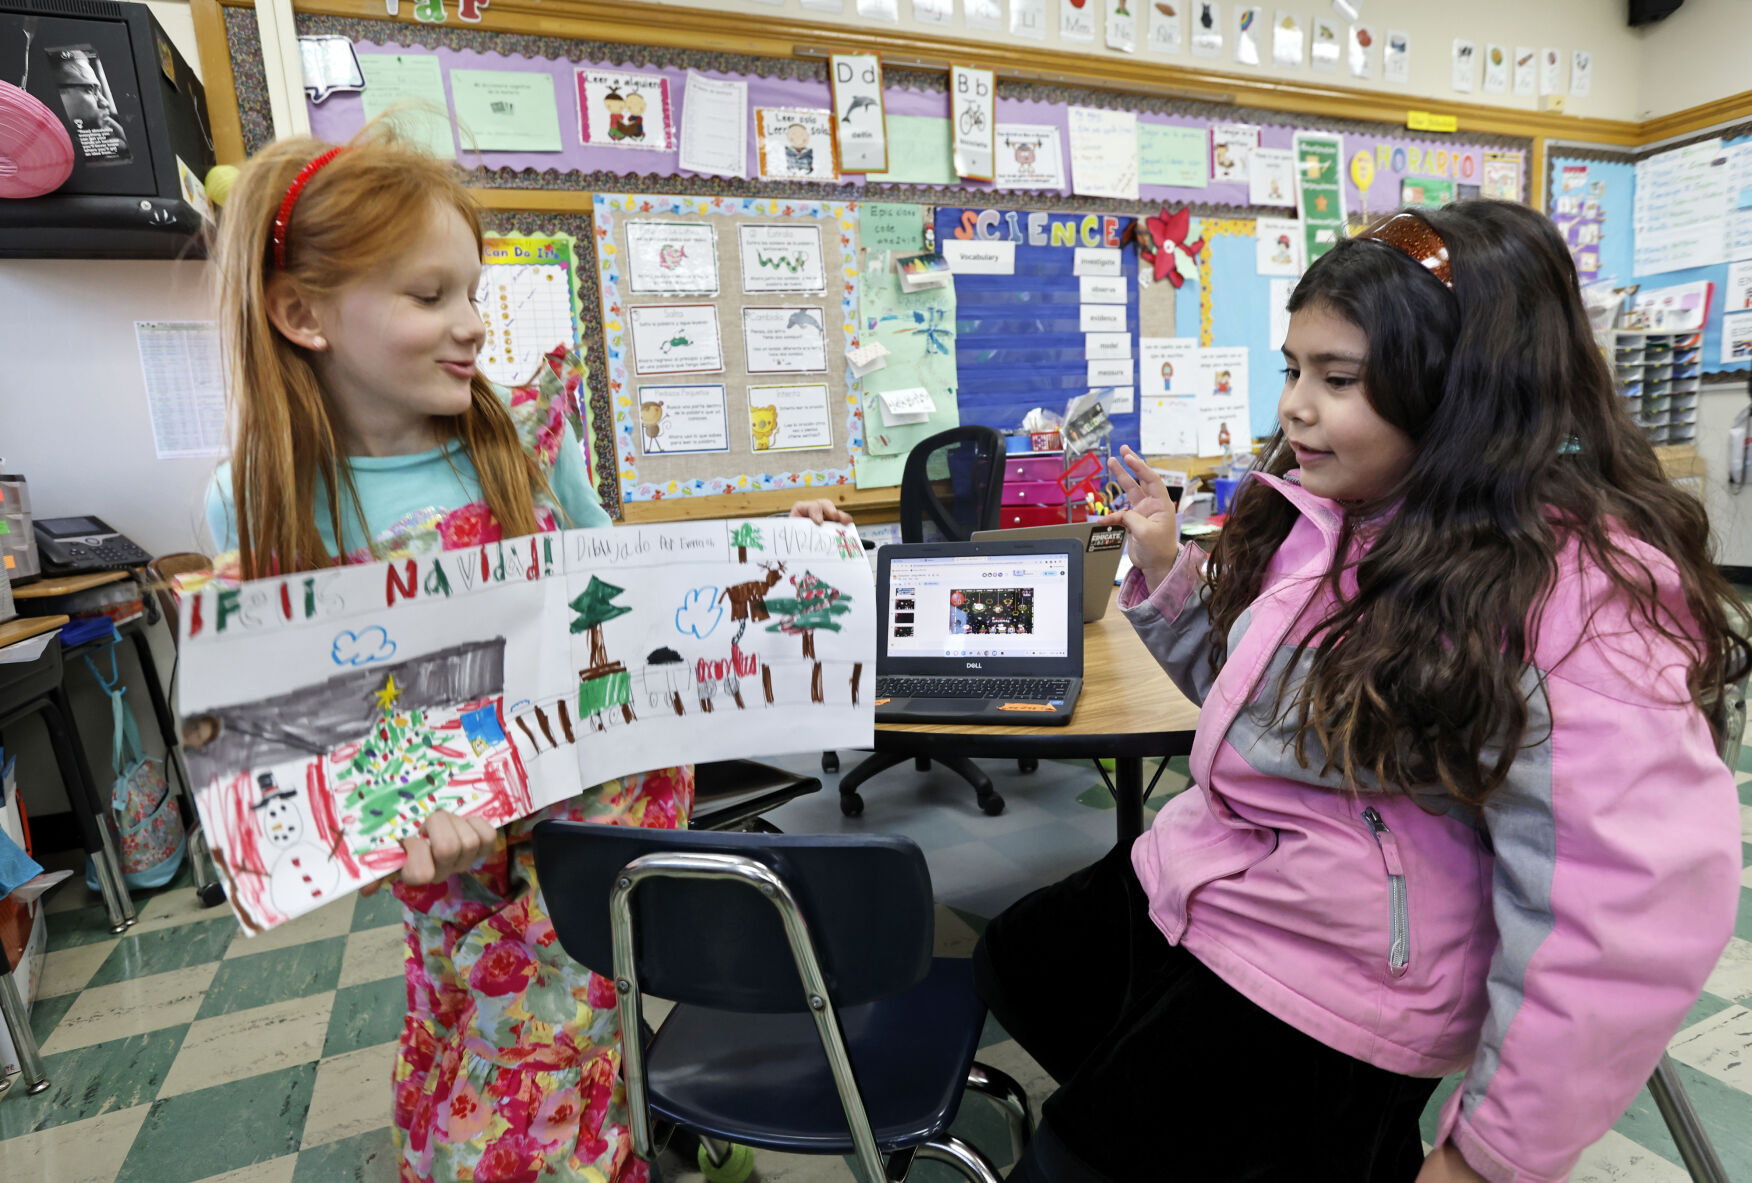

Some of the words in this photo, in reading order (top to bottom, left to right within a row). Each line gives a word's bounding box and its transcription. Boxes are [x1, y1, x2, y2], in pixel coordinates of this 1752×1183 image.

[837, 62, 853, 84] D
[861, 66, 875, 84] d
[585, 72, 608, 84] Leer
[613, 78, 620, 86] a
[624, 75, 661, 93] alguien
[958, 73, 969, 94] B
[976, 78, 988, 97] b
[775, 113, 795, 123] Leer
[800, 114, 817, 125] solo
[766, 124, 788, 136] Leer
[1375, 144, 1475, 179] HORARIO
[954, 209, 1121, 248] SCIENCE
[484, 246, 508, 258] Can
[514, 246, 531, 258] Do
[960, 252, 999, 263] Vocabulary
[1090, 314, 1118, 322] evidence
[1099, 341, 1118, 349] model
